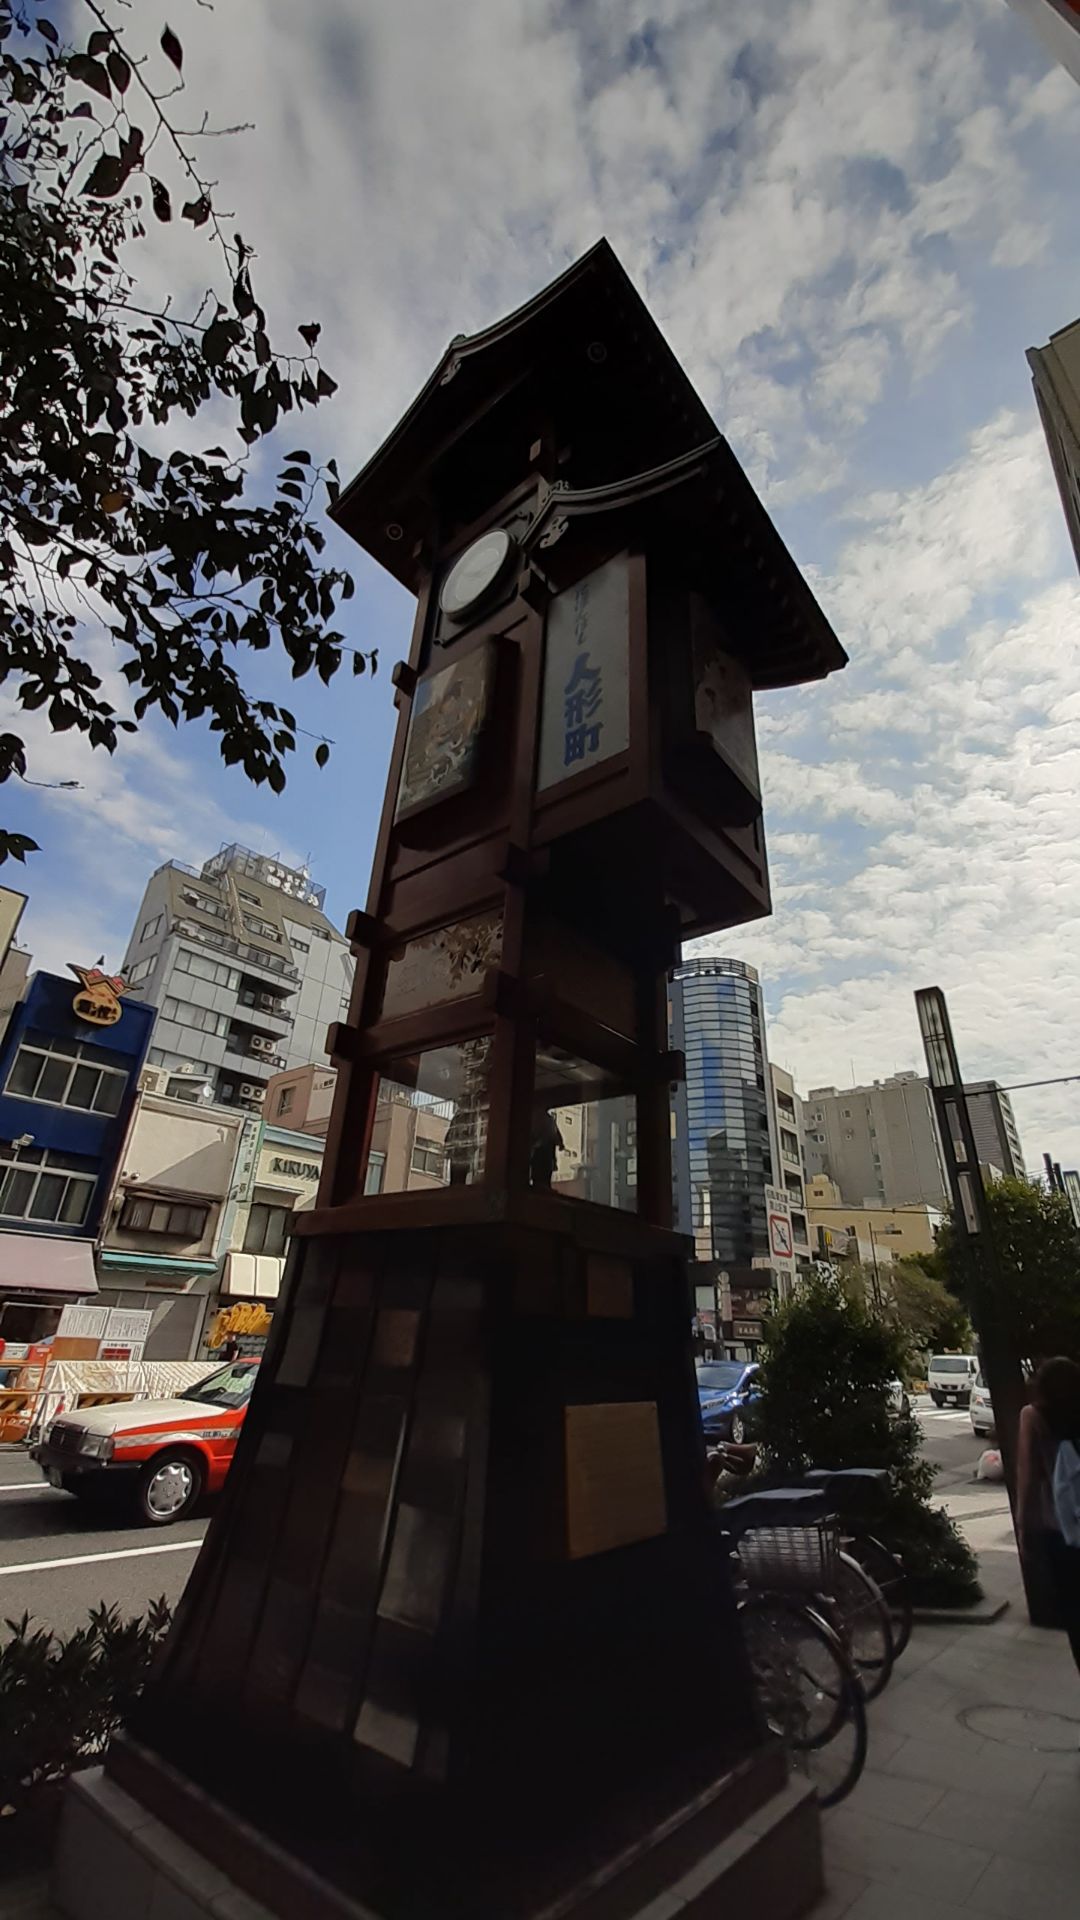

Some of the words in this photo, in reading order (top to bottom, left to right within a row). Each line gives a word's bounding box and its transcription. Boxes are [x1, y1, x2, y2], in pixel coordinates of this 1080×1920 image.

[564, 652, 604, 767] 人形町
[273, 1157, 320, 1179] KIKUYA
